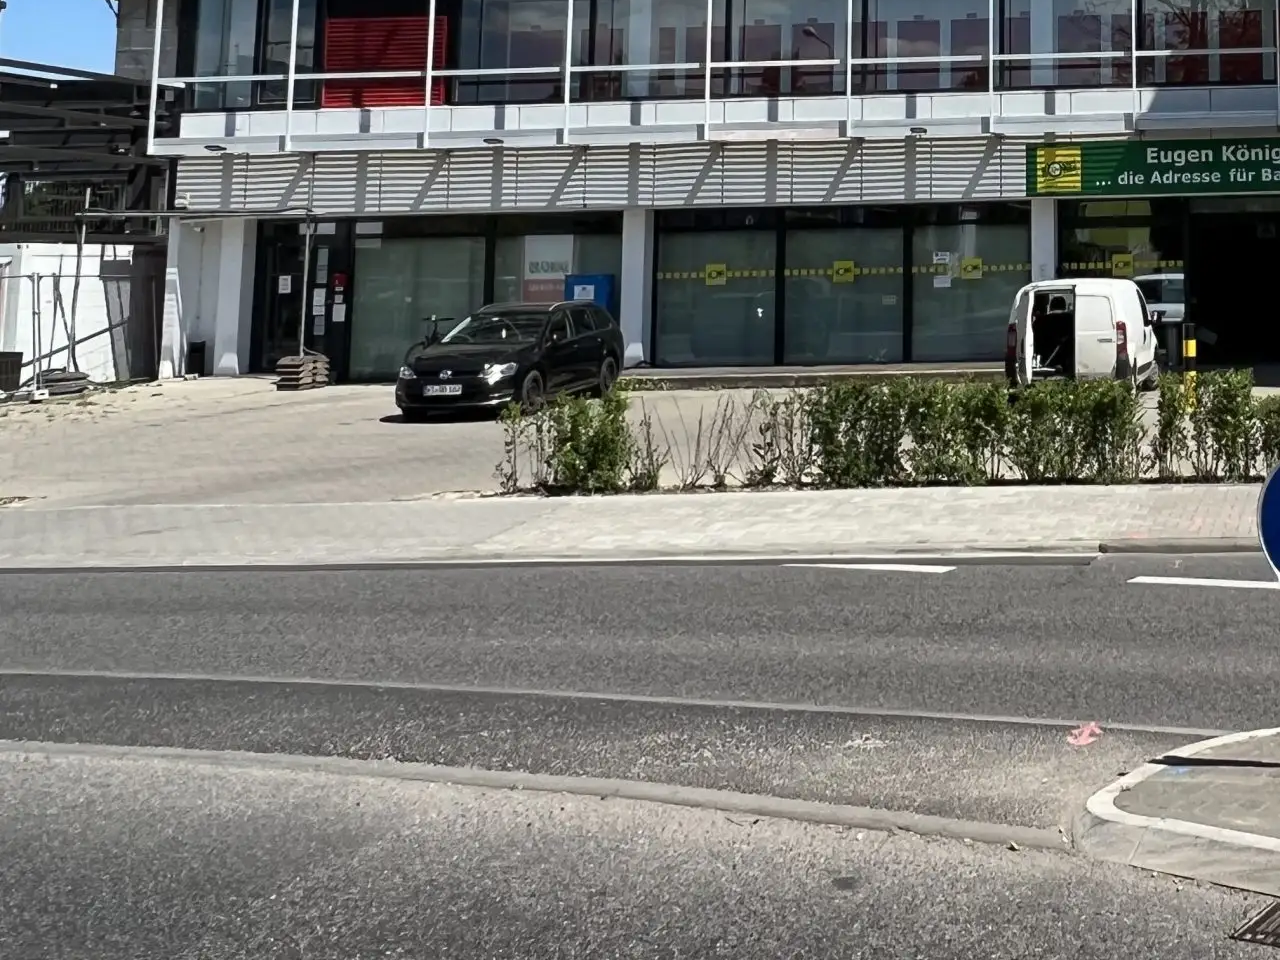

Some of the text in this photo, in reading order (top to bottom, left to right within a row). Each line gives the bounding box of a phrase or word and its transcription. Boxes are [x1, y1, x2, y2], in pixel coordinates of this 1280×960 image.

[1146, 147, 1213, 167] Eugen
[1117, 170, 1145, 185] die
[1150, 169, 1221, 184] Adresse
[1229, 168, 1256, 182] für
